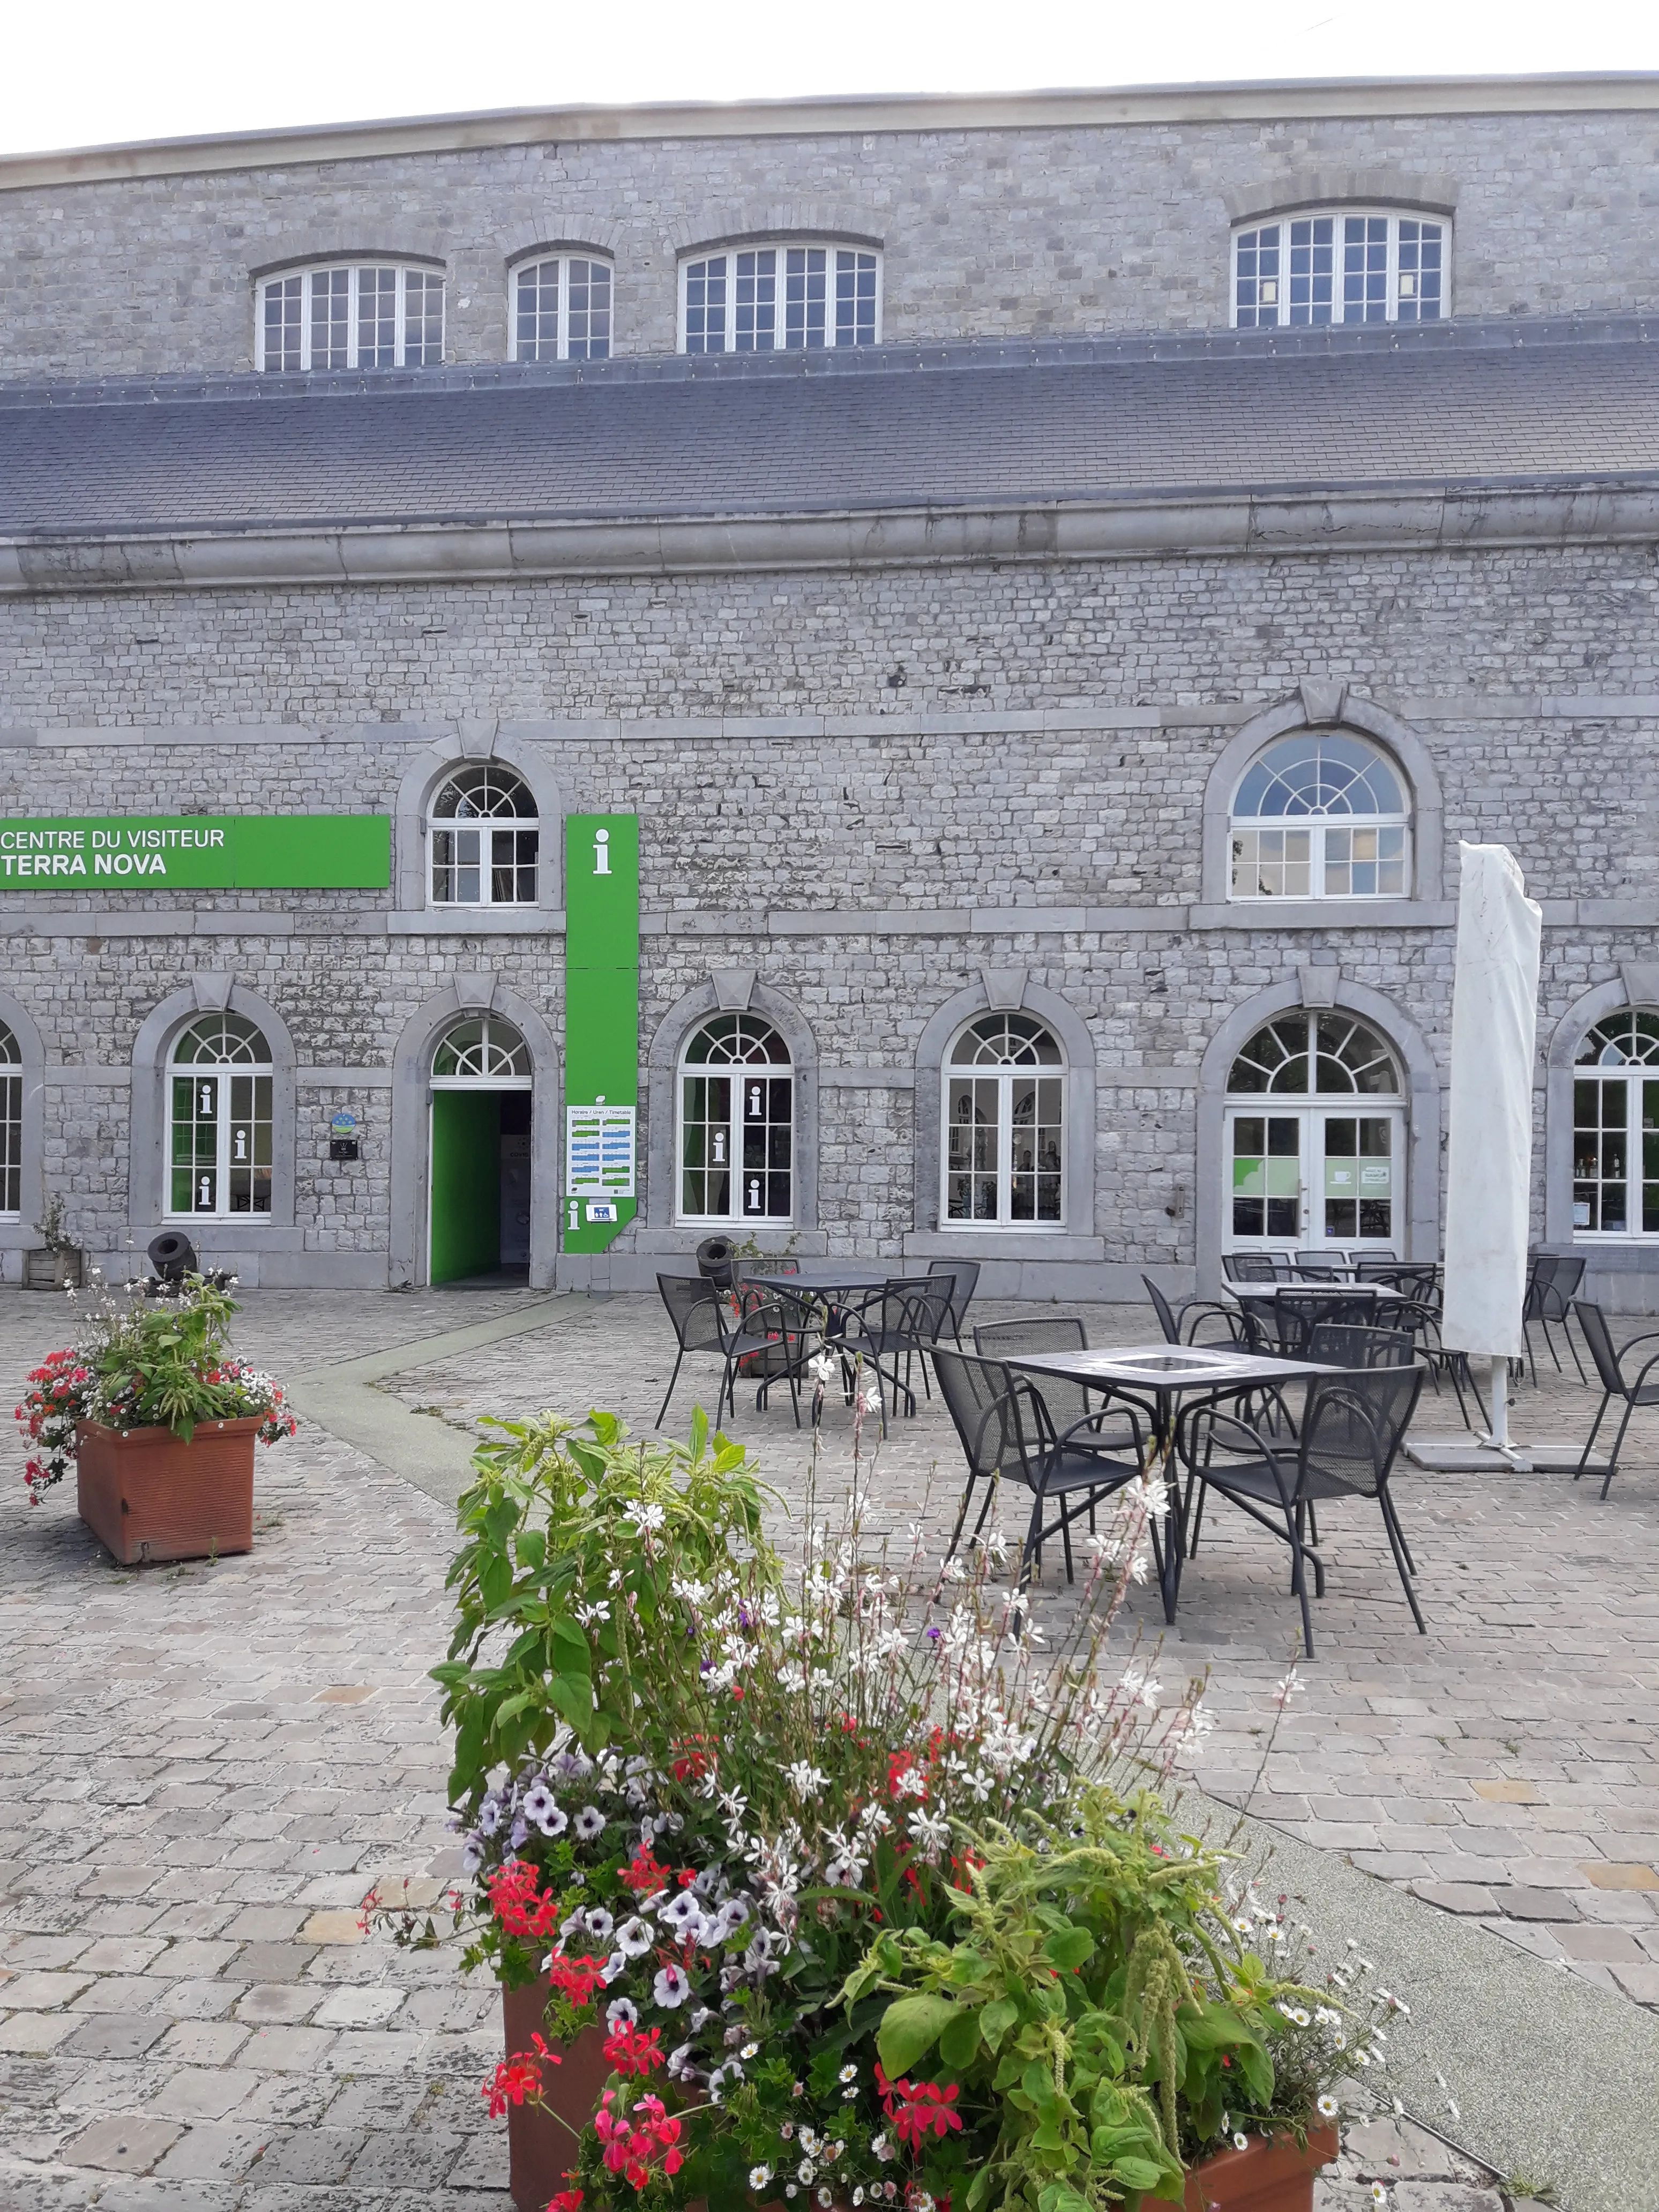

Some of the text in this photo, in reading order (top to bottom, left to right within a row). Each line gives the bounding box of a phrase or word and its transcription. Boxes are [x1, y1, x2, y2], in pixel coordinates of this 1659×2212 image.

[1, 829, 225, 849] CENTRE DU VISITEUR
[0, 853, 167, 876] TERRA NOVA
